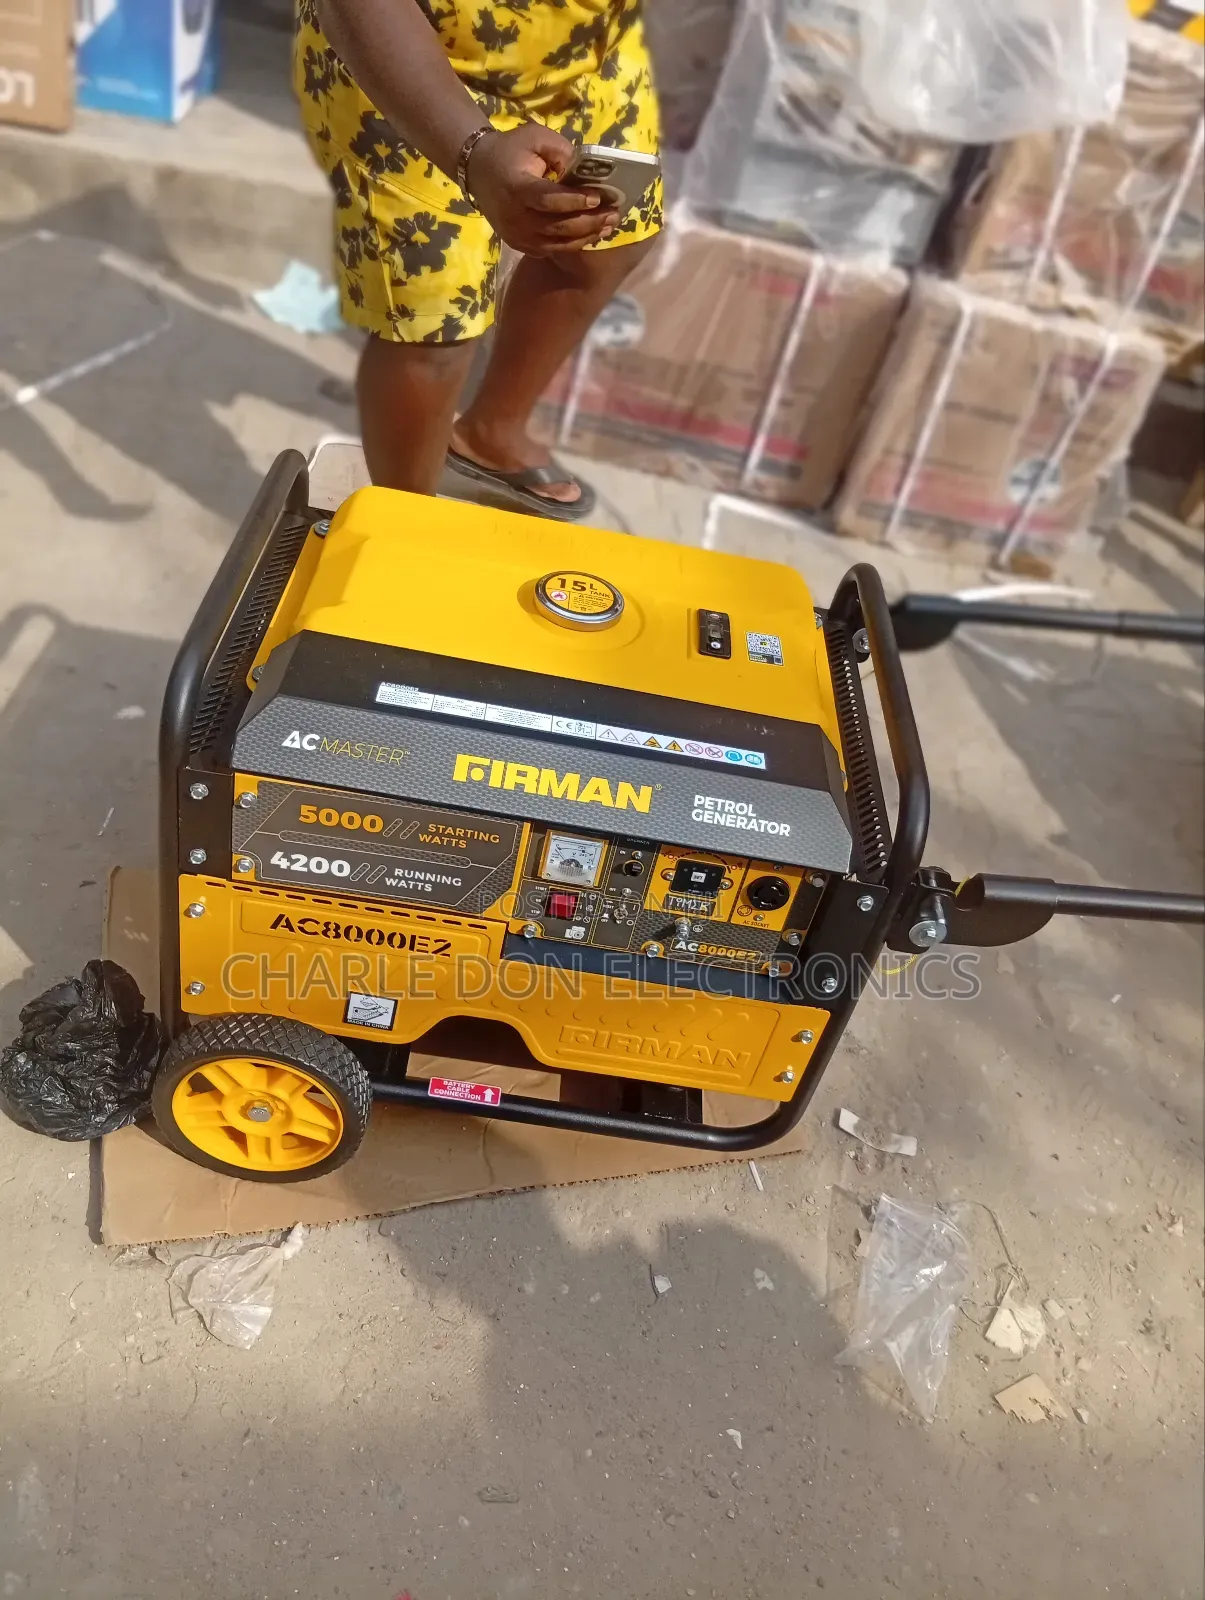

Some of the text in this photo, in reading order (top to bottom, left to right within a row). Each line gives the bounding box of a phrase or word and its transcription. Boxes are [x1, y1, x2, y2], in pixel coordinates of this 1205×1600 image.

[590, 590, 611, 599] TANK
[693, 794, 757, 818] PETROL
[298, 804, 500, 844] 5000 STARTING
[691, 808, 791, 837] GENERATOR
[418, 833, 468, 849] WATTS
[270, 851, 463, 887] 4200 RUNNING
[384, 877, 433, 892] WATTS
[269, 912, 453, 958] AC8000E2
[674, 940, 758, 962] AC8000E2
[558, 1026, 751, 1069] FIRMAN
[433, 1088, 481, 1101] CONNECTION
[443, 1080, 476, 1090] BATTERY
[446, 1085, 470, 1094] CABLE
